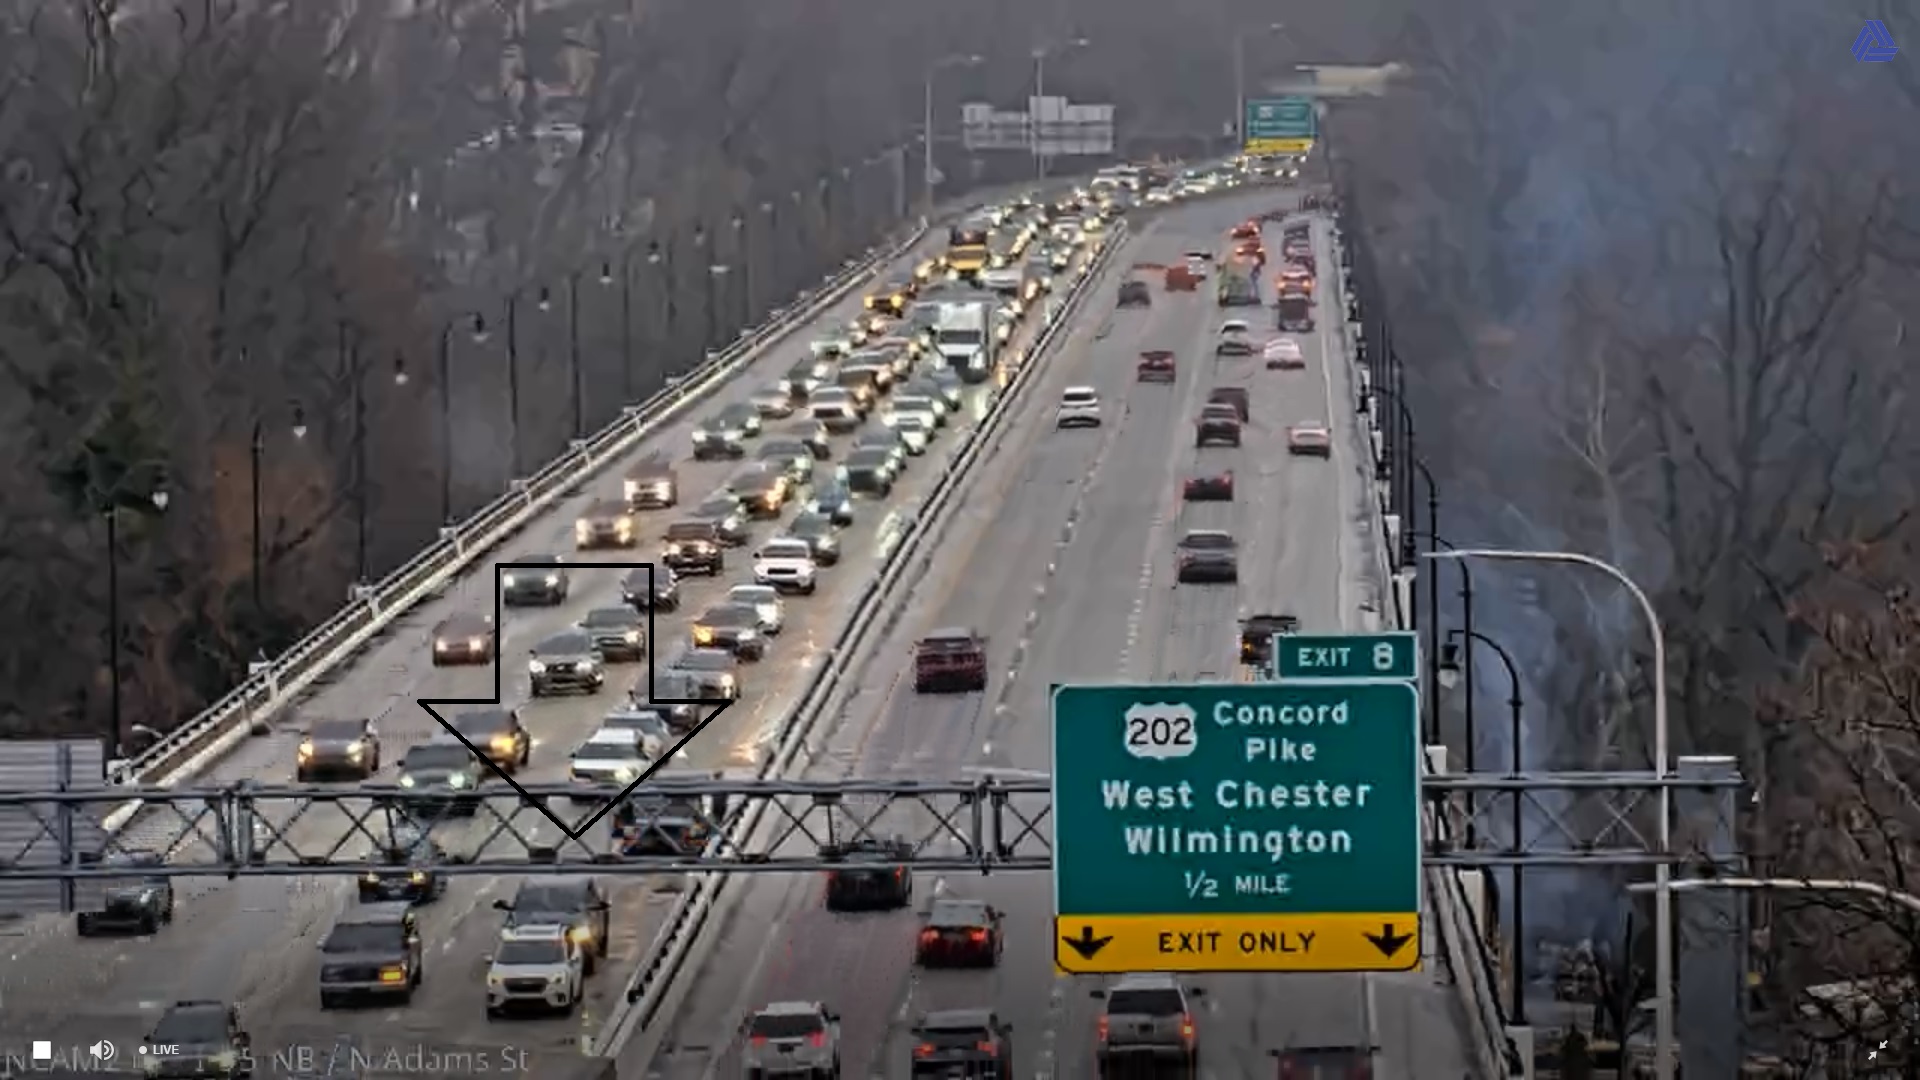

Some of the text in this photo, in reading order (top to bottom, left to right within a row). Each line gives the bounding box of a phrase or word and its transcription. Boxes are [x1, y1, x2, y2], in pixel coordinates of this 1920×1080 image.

[1298, 642, 1394, 671] EXIT 8
[1212, 700, 1350, 726] Concord
[1128, 717, 1194, 747] 202
[1245, 737, 1317, 762] Pike
[1101, 779, 1372, 810] West Chester
[1124, 825, 1352, 862] Wilmington
[1235, 874, 1292, 895] MILE
[1158, 931, 1317, 953] EXIT ONLY
